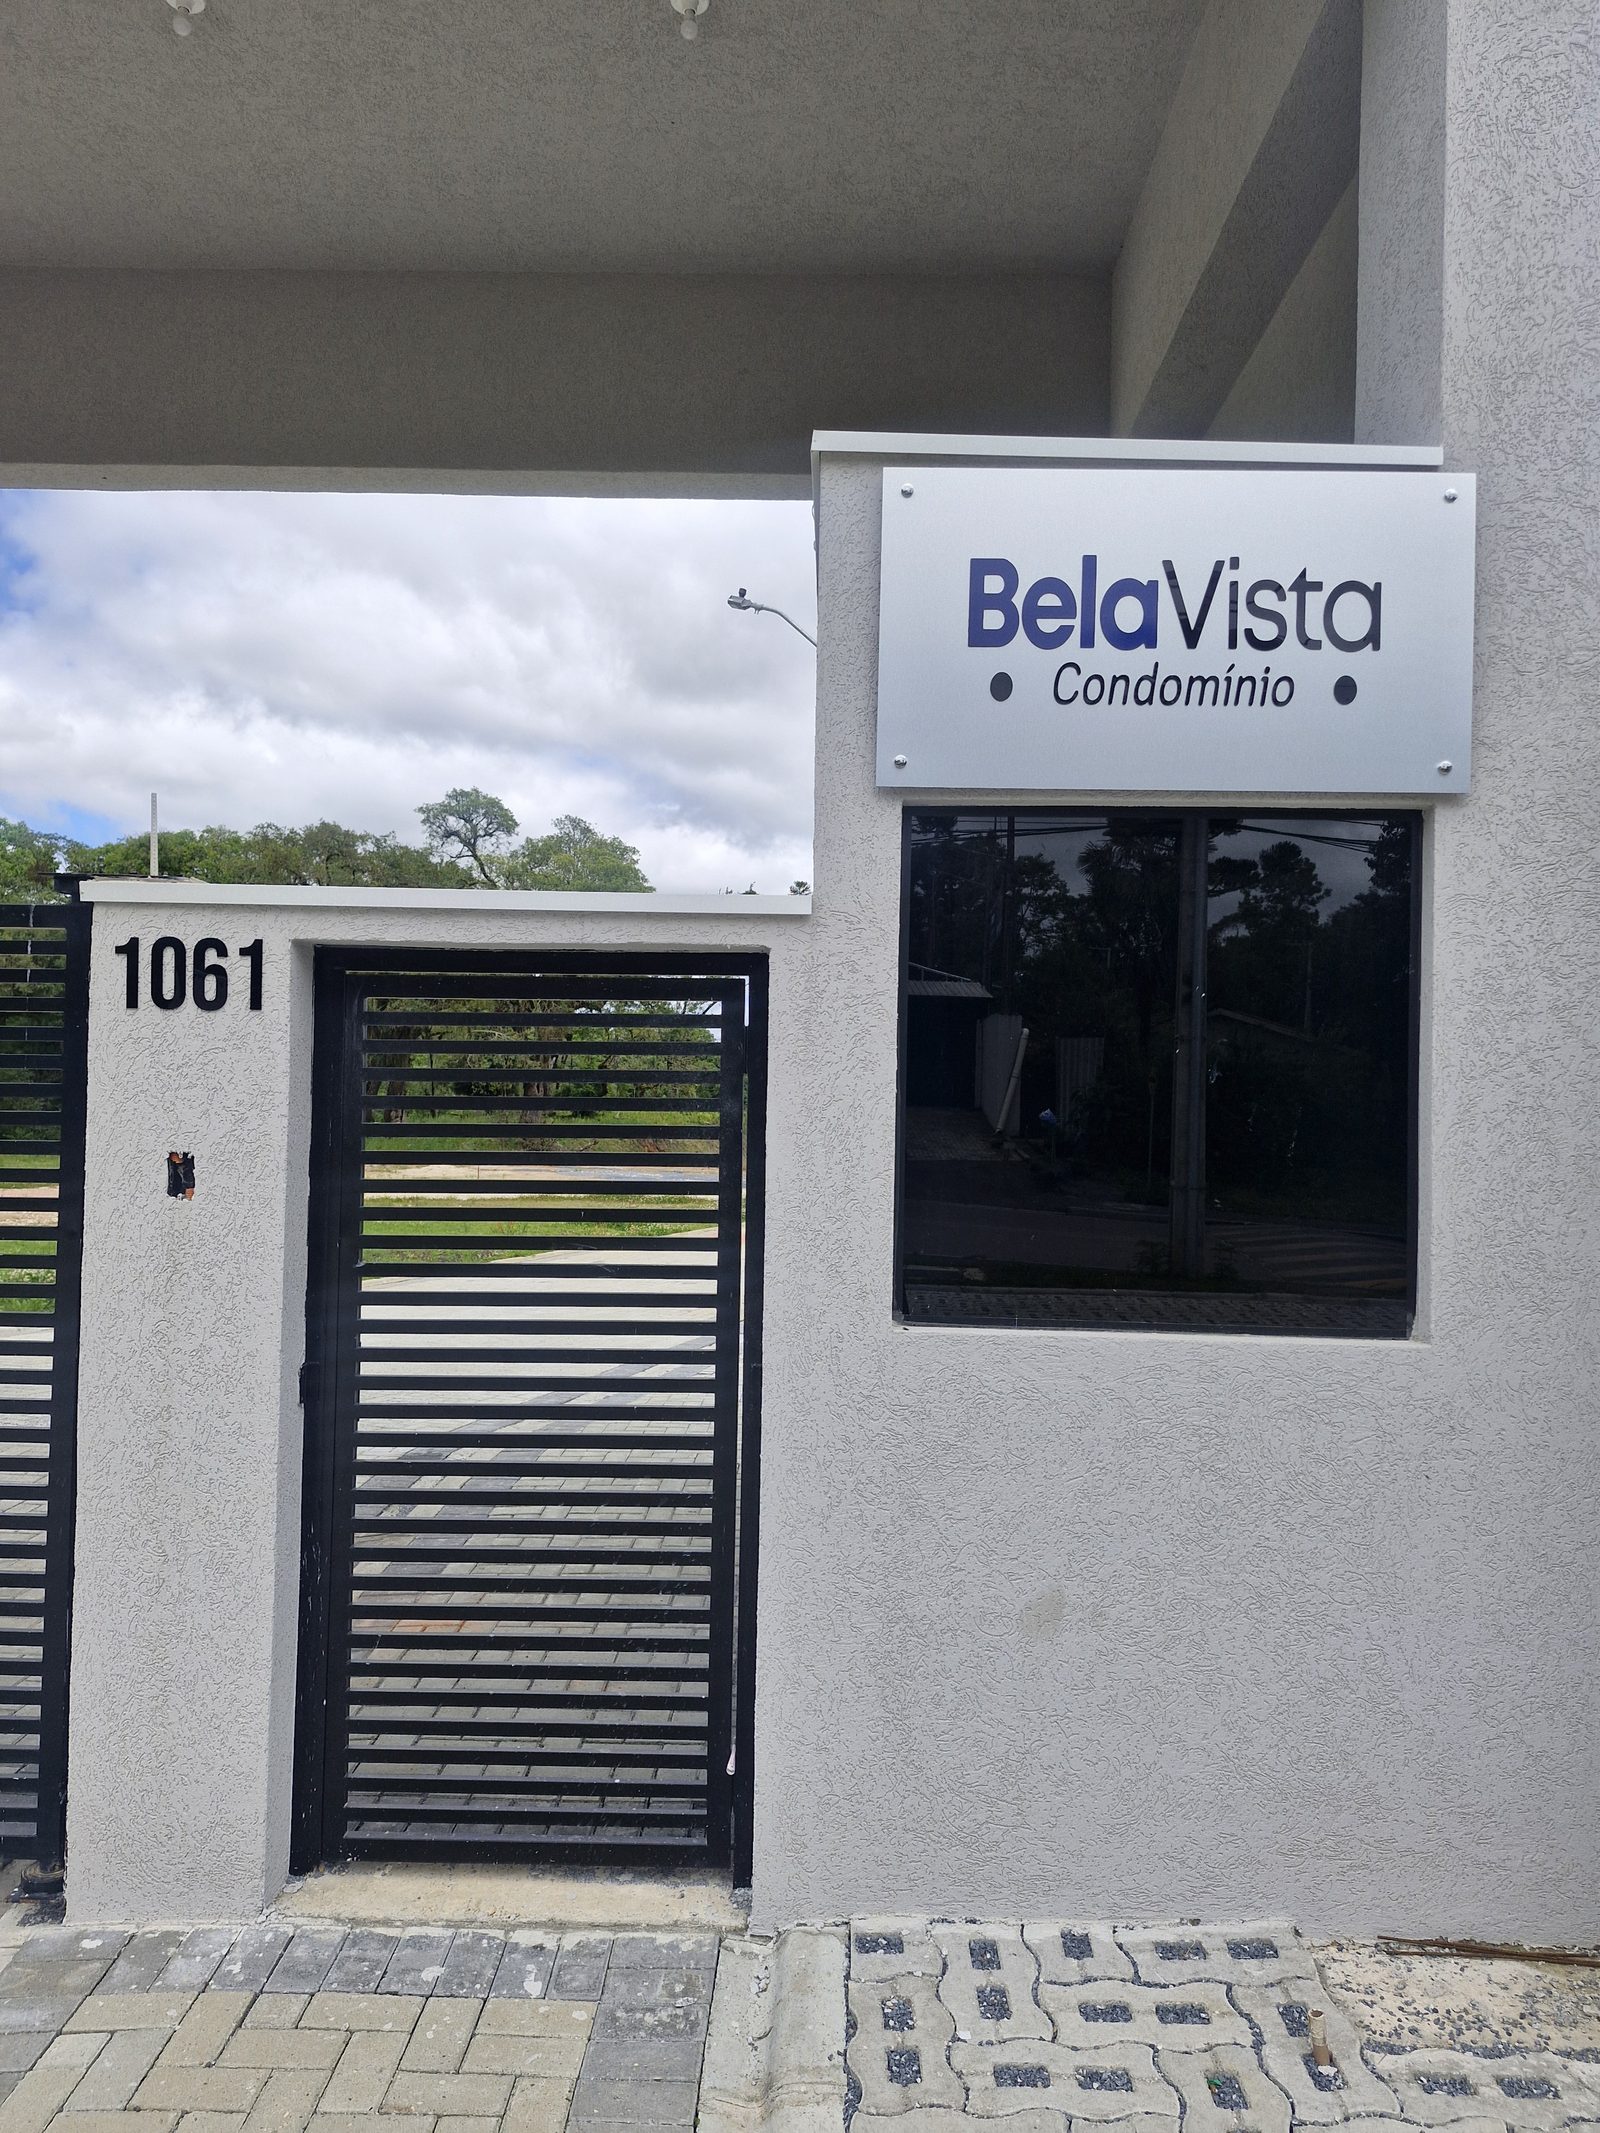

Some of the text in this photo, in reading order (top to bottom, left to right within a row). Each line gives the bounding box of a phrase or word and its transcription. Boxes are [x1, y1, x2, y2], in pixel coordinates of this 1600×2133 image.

[968, 555, 1382, 652] BelaVista
[1053, 662, 1295, 707] Condomínio
[115, 936, 263, 1011] 1061
